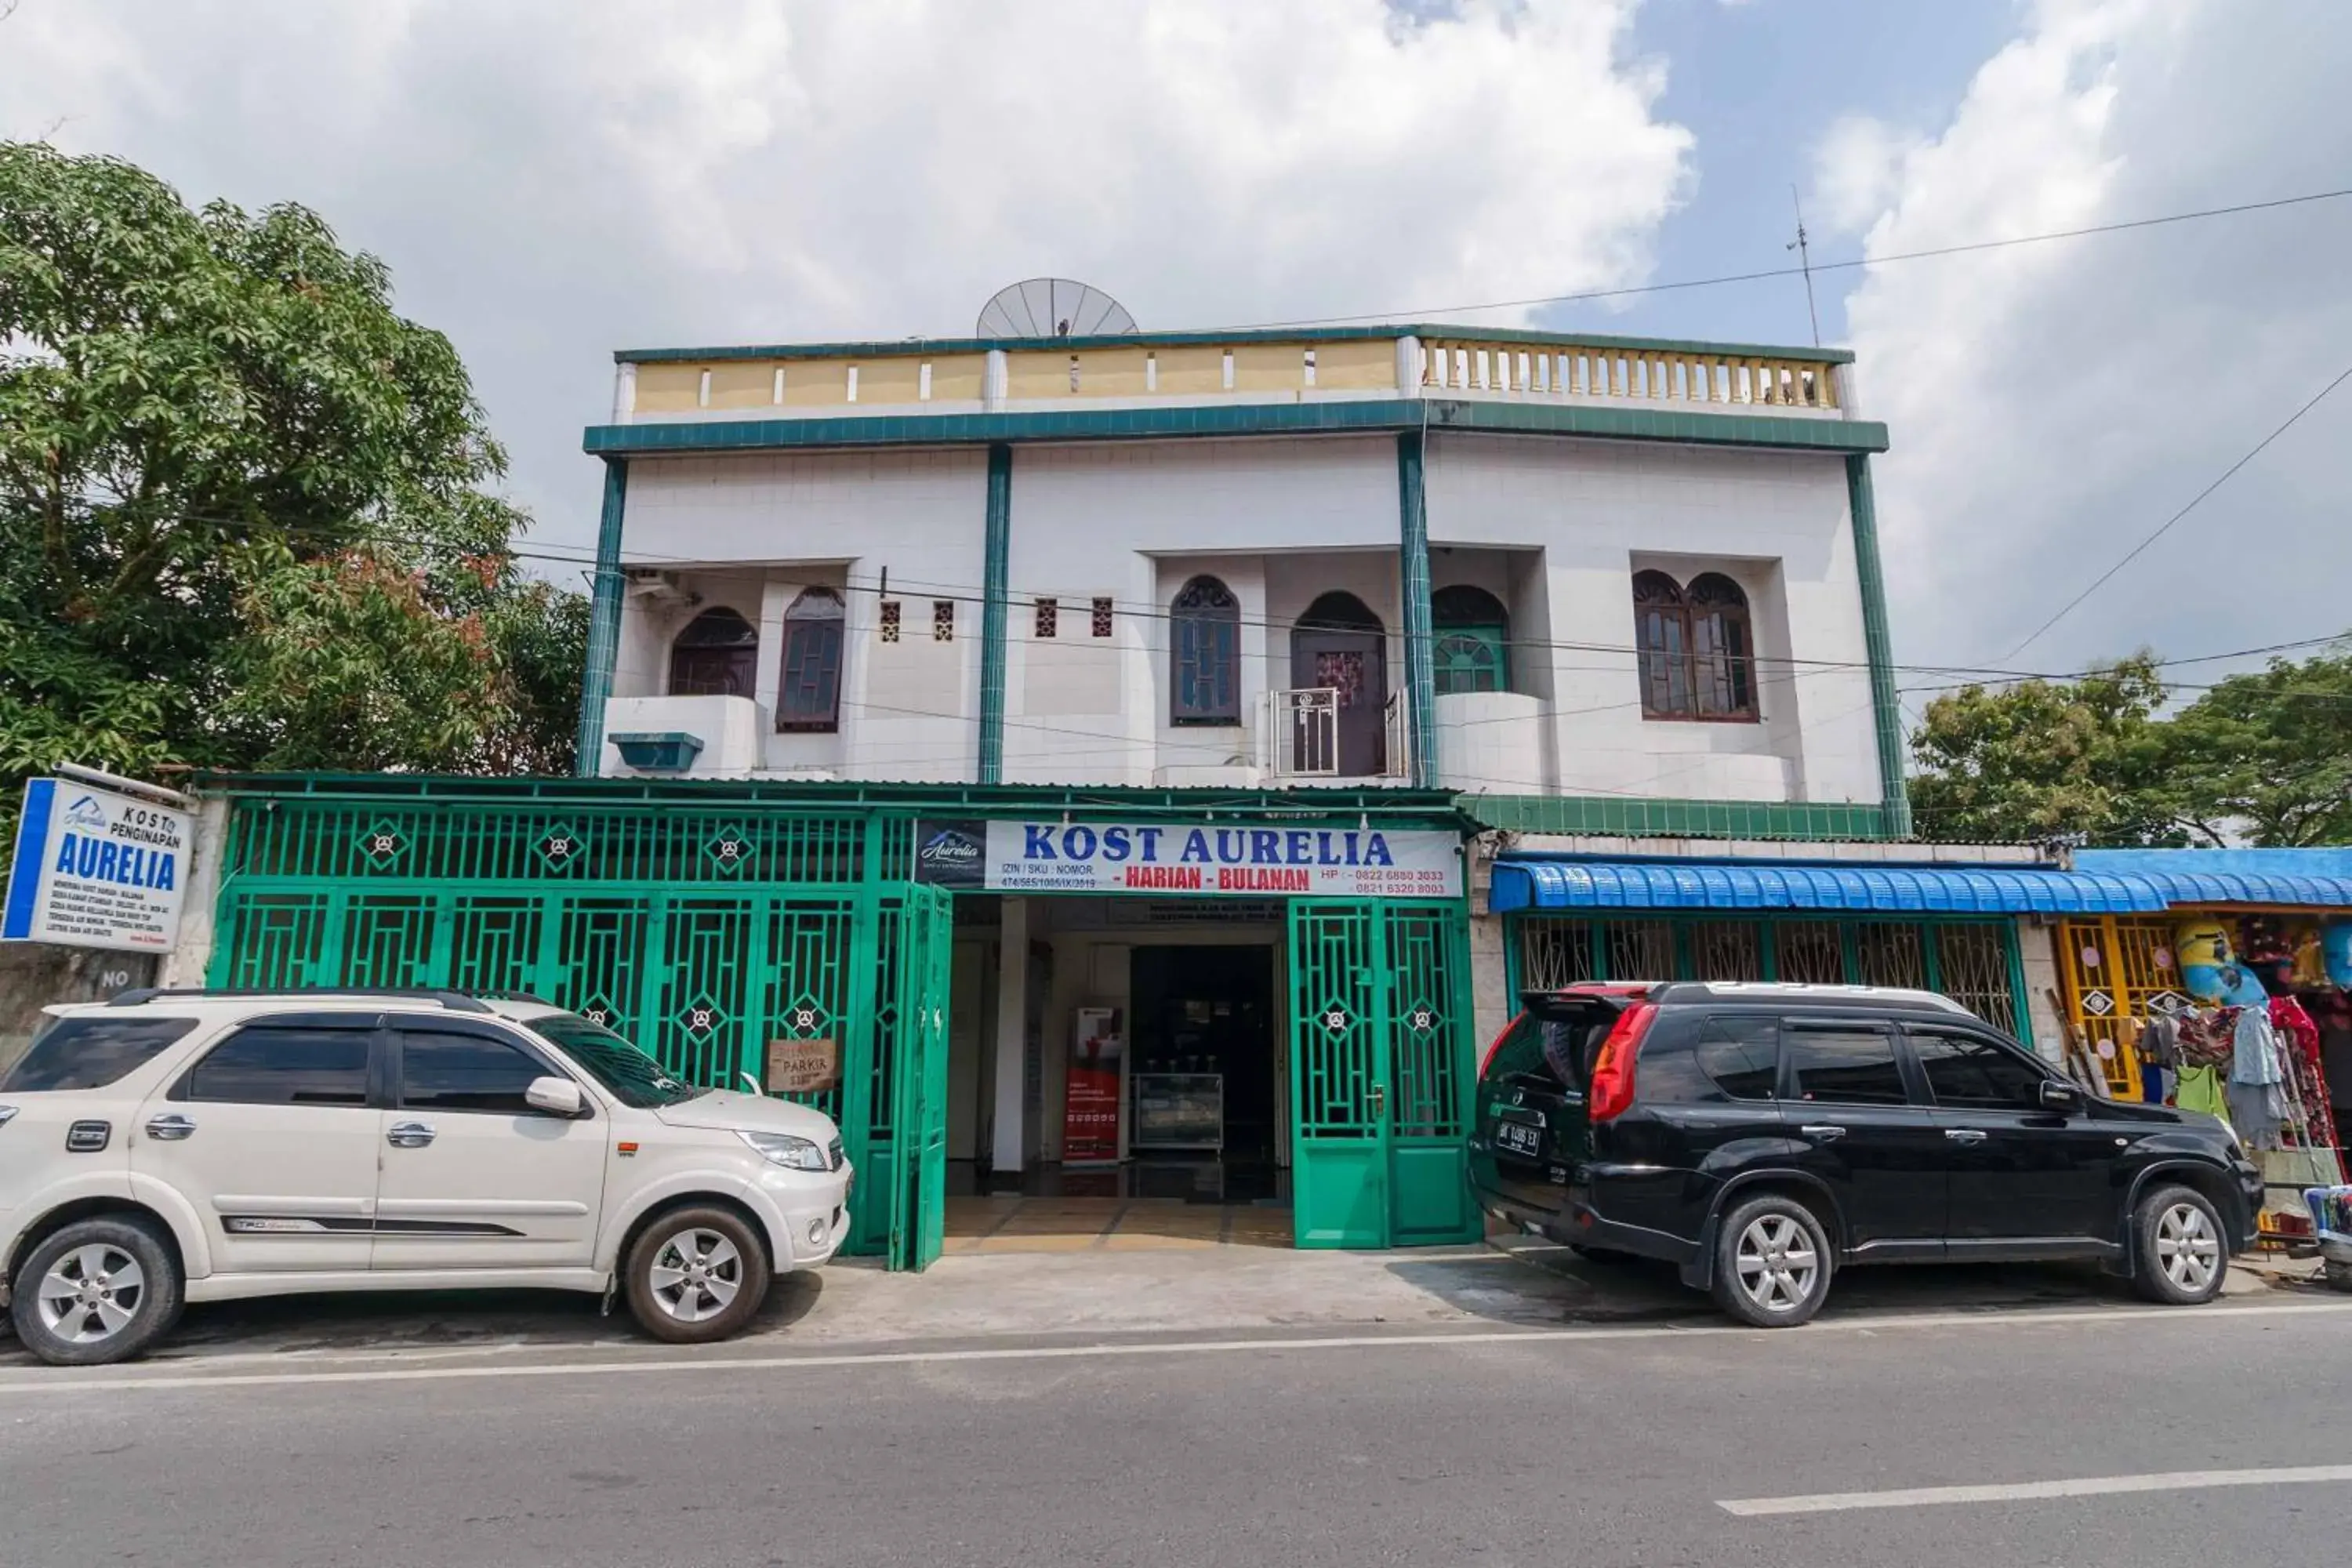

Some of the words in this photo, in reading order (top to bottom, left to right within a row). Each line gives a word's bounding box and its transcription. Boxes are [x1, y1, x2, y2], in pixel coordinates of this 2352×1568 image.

[122, 807, 169, 830] KOST
[111, 822, 180, 848] PENGINAPAN
[1023, 825, 1163, 862] KOST
[1181, 828, 1394, 866] AURELIA
[56, 833, 175, 891] AURELIA
[921, 841, 978, 860] Aurelia
[1126, 866, 1201, 890] HARIAN
[1218, 868, 1309, 891] BULANAN
[1321, 869, 1339, 879] HP
[102, 970, 129, 988] NO
[783, 1057, 827, 1073] PARKIR
